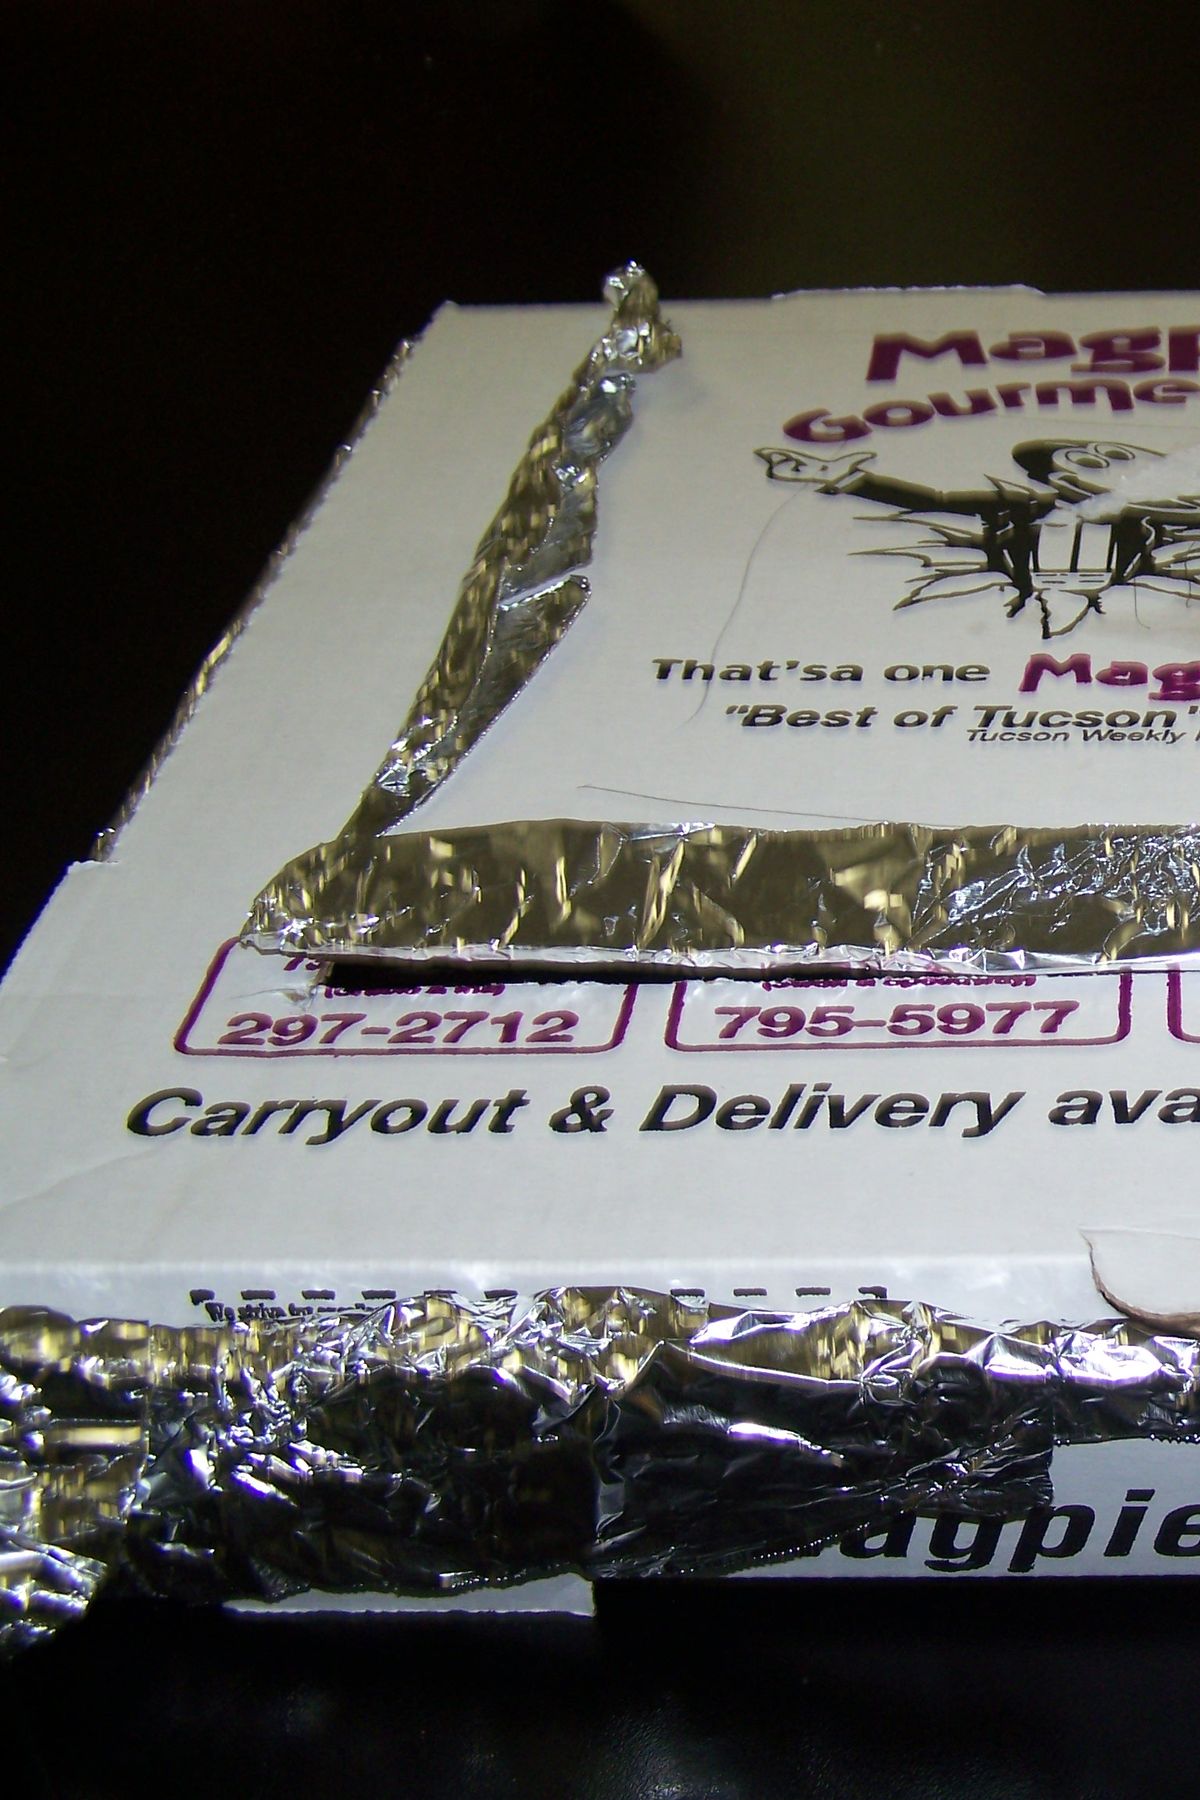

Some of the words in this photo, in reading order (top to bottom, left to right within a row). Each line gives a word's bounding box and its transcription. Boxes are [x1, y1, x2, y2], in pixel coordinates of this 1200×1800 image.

[652, 659, 863, 681] That'sa
[884, 663, 990, 682] one
[726, 704, 878, 727] "Best
[894, 704, 959, 727] of
[967, 729, 1070, 742] Tucson
[1083, 728, 1184, 744] Weekly
[217, 1010, 580, 1046] 297-2712
[714, 1001, 1079, 1039] 795-5977
[126, 1087, 530, 1146] Carryout
[549, 1086, 615, 1133] &
[639, 1082, 1026, 1138] Delivery
